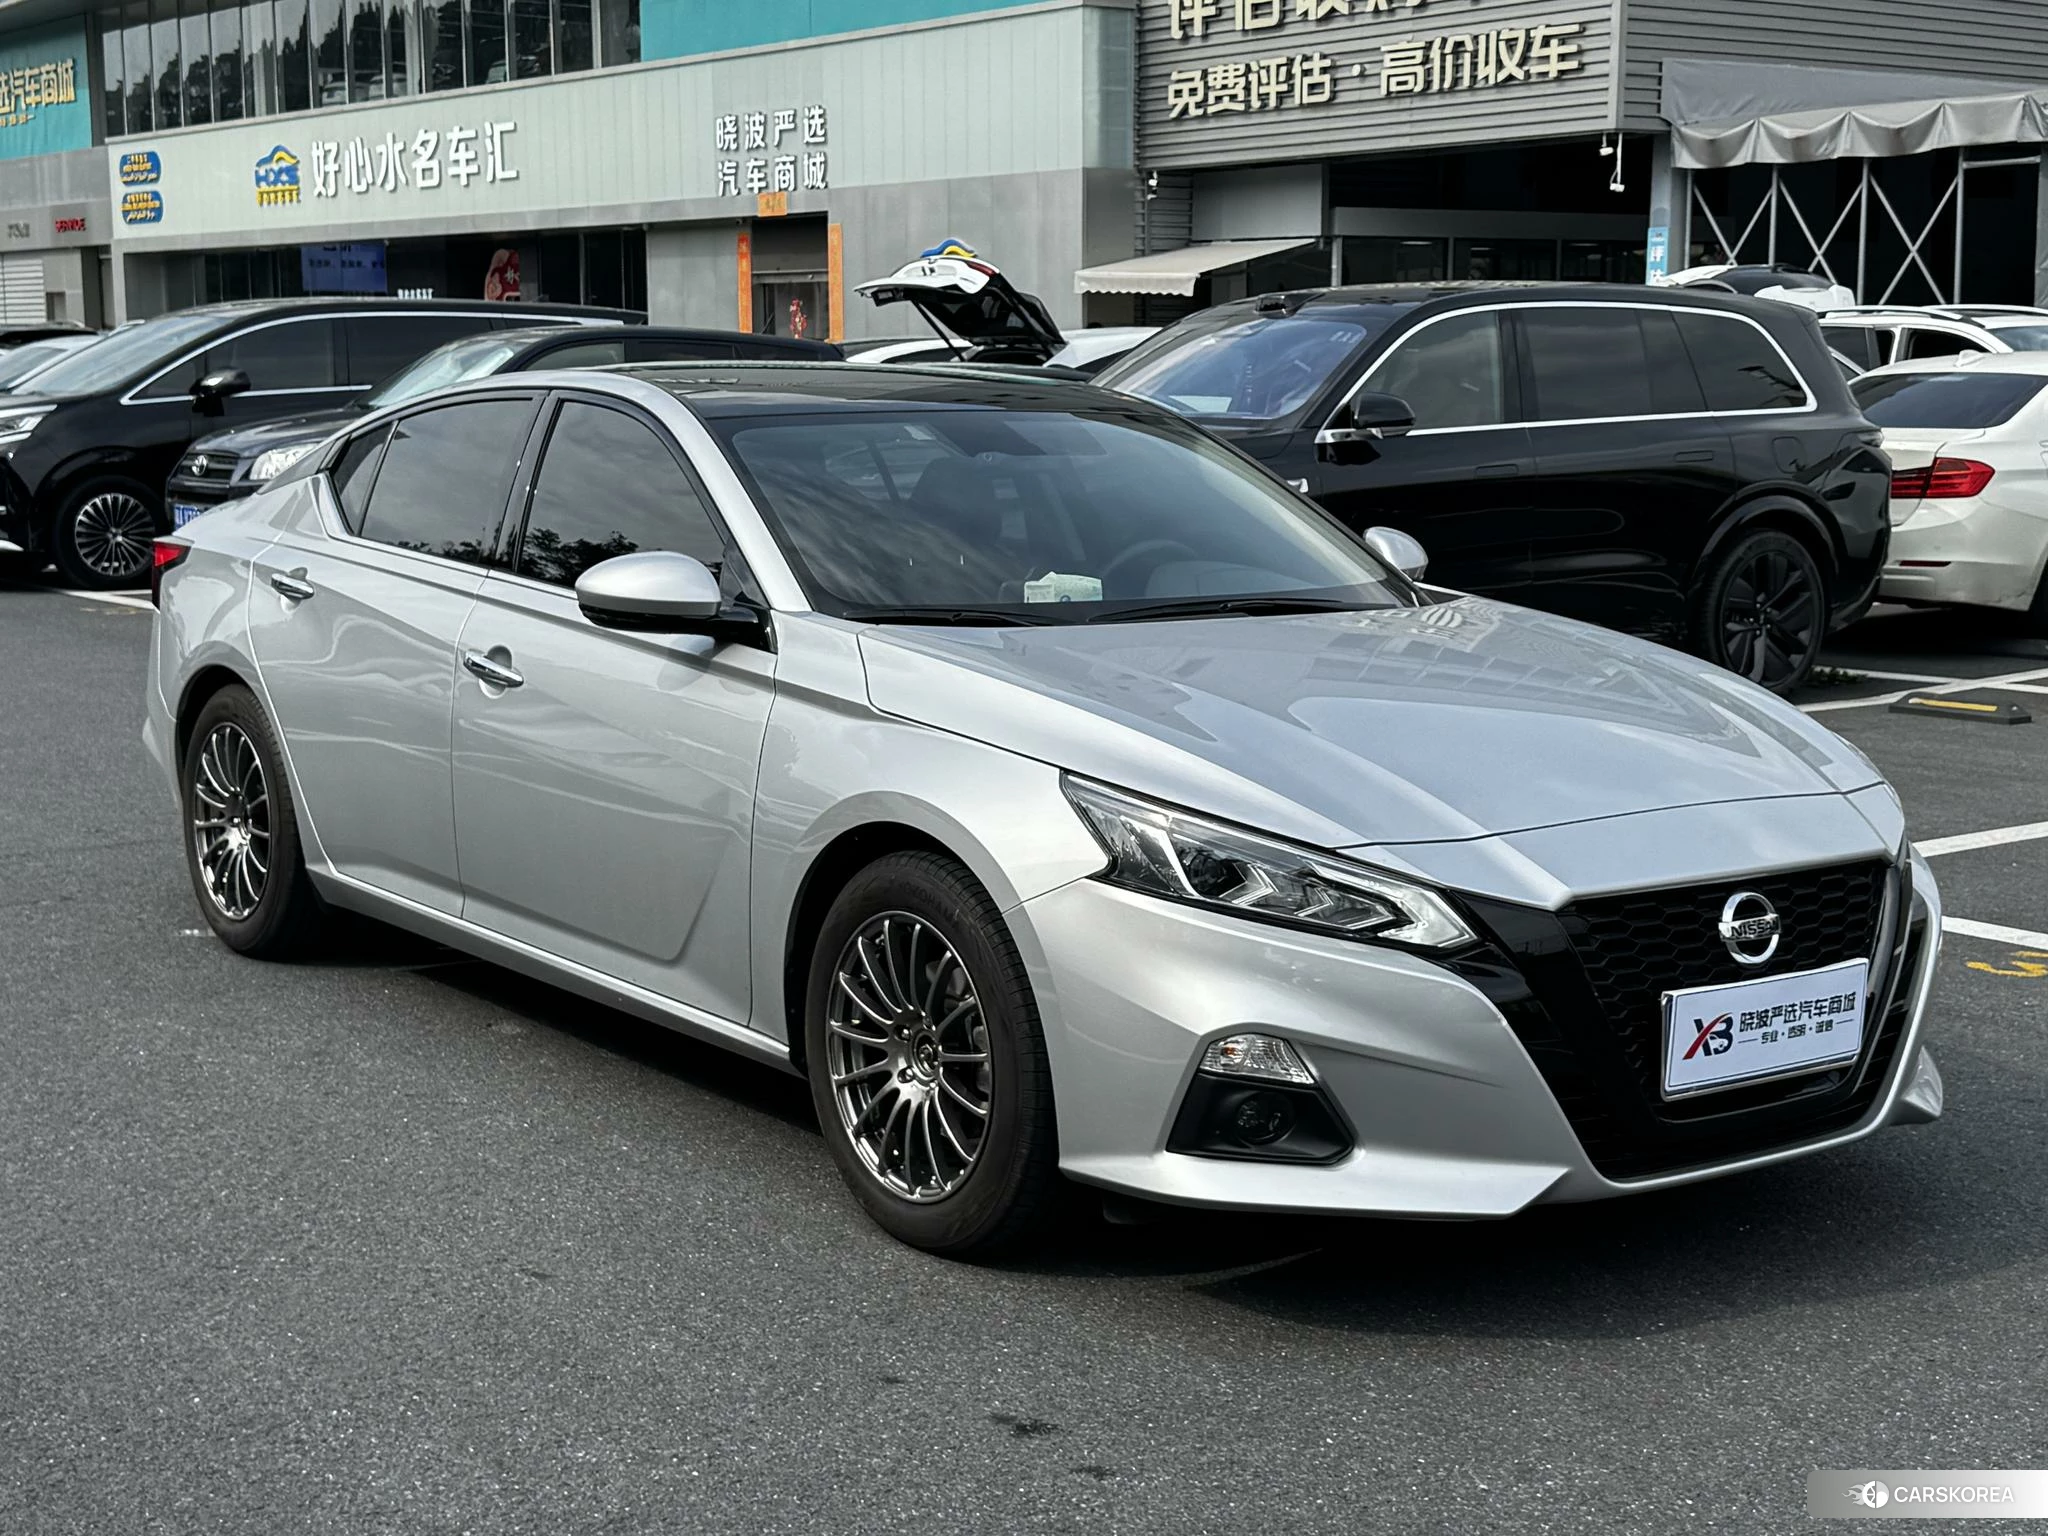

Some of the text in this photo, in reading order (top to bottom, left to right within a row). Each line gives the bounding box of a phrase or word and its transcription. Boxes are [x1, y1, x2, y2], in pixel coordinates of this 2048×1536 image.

[716, 105, 826, 151] 晓波严选
[312, 121, 519, 198] 好心水名车汇
[718, 151, 828, 197] 汽车商城
[1739, 991, 1856, 1033] 晓波严选汽车商城
